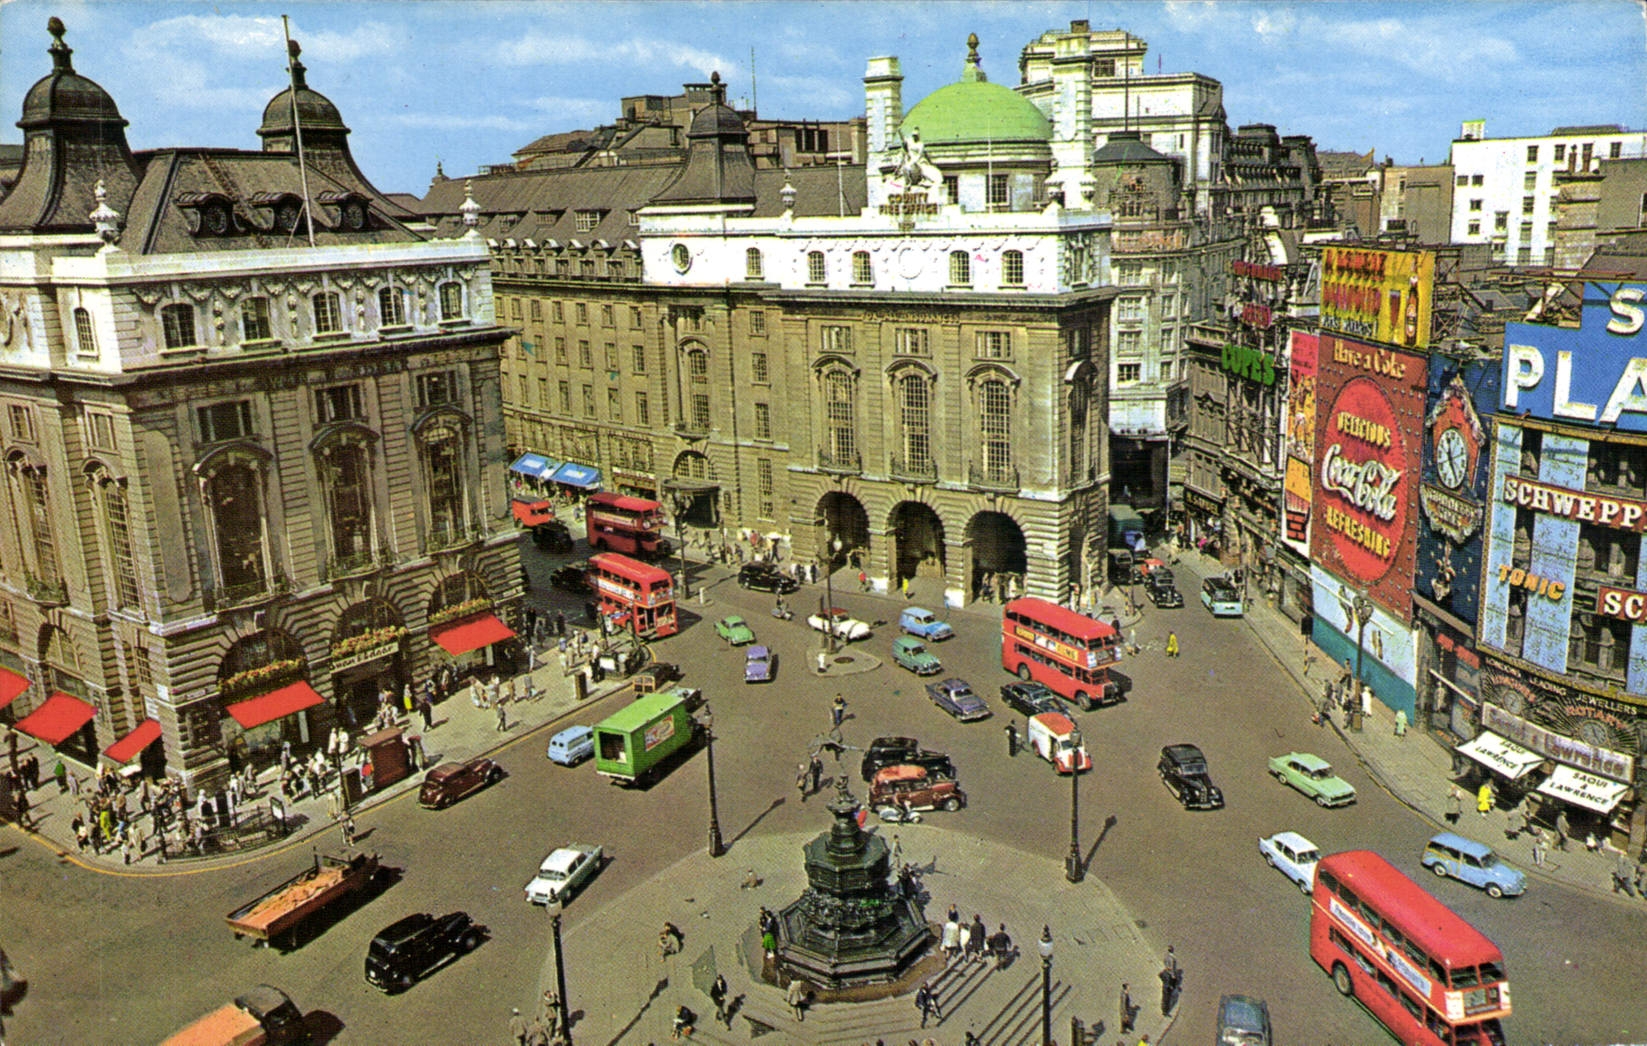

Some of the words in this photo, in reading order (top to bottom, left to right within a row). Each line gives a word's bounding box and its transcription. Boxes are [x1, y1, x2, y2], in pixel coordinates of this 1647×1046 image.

[879, 203, 900, 216] FIRE
[902, 202, 938, 216] OFFICE
[888, 192, 928, 204] COUNTY
[1333, 338, 1362, 367] Have
[1363, 354, 1372, 370] a
[1373, 348, 1407, 380] Coke
[1504, 344, 1647, 423] PLA
[1337, 411, 1391, 448] DELICIOUS
[1504, 479, 1647, 529] SCHWEPP
[1326, 505, 1391, 559] REFRESHING
[1499, 564, 1565, 600] TONIC
[1604, 591, 1647, 619] SC
[1576, 694, 1637, 715] JEWELLERS
[1549, 781, 1609, 805] LAWRENCE
[1572, 772, 1608, 788] SAQUI
